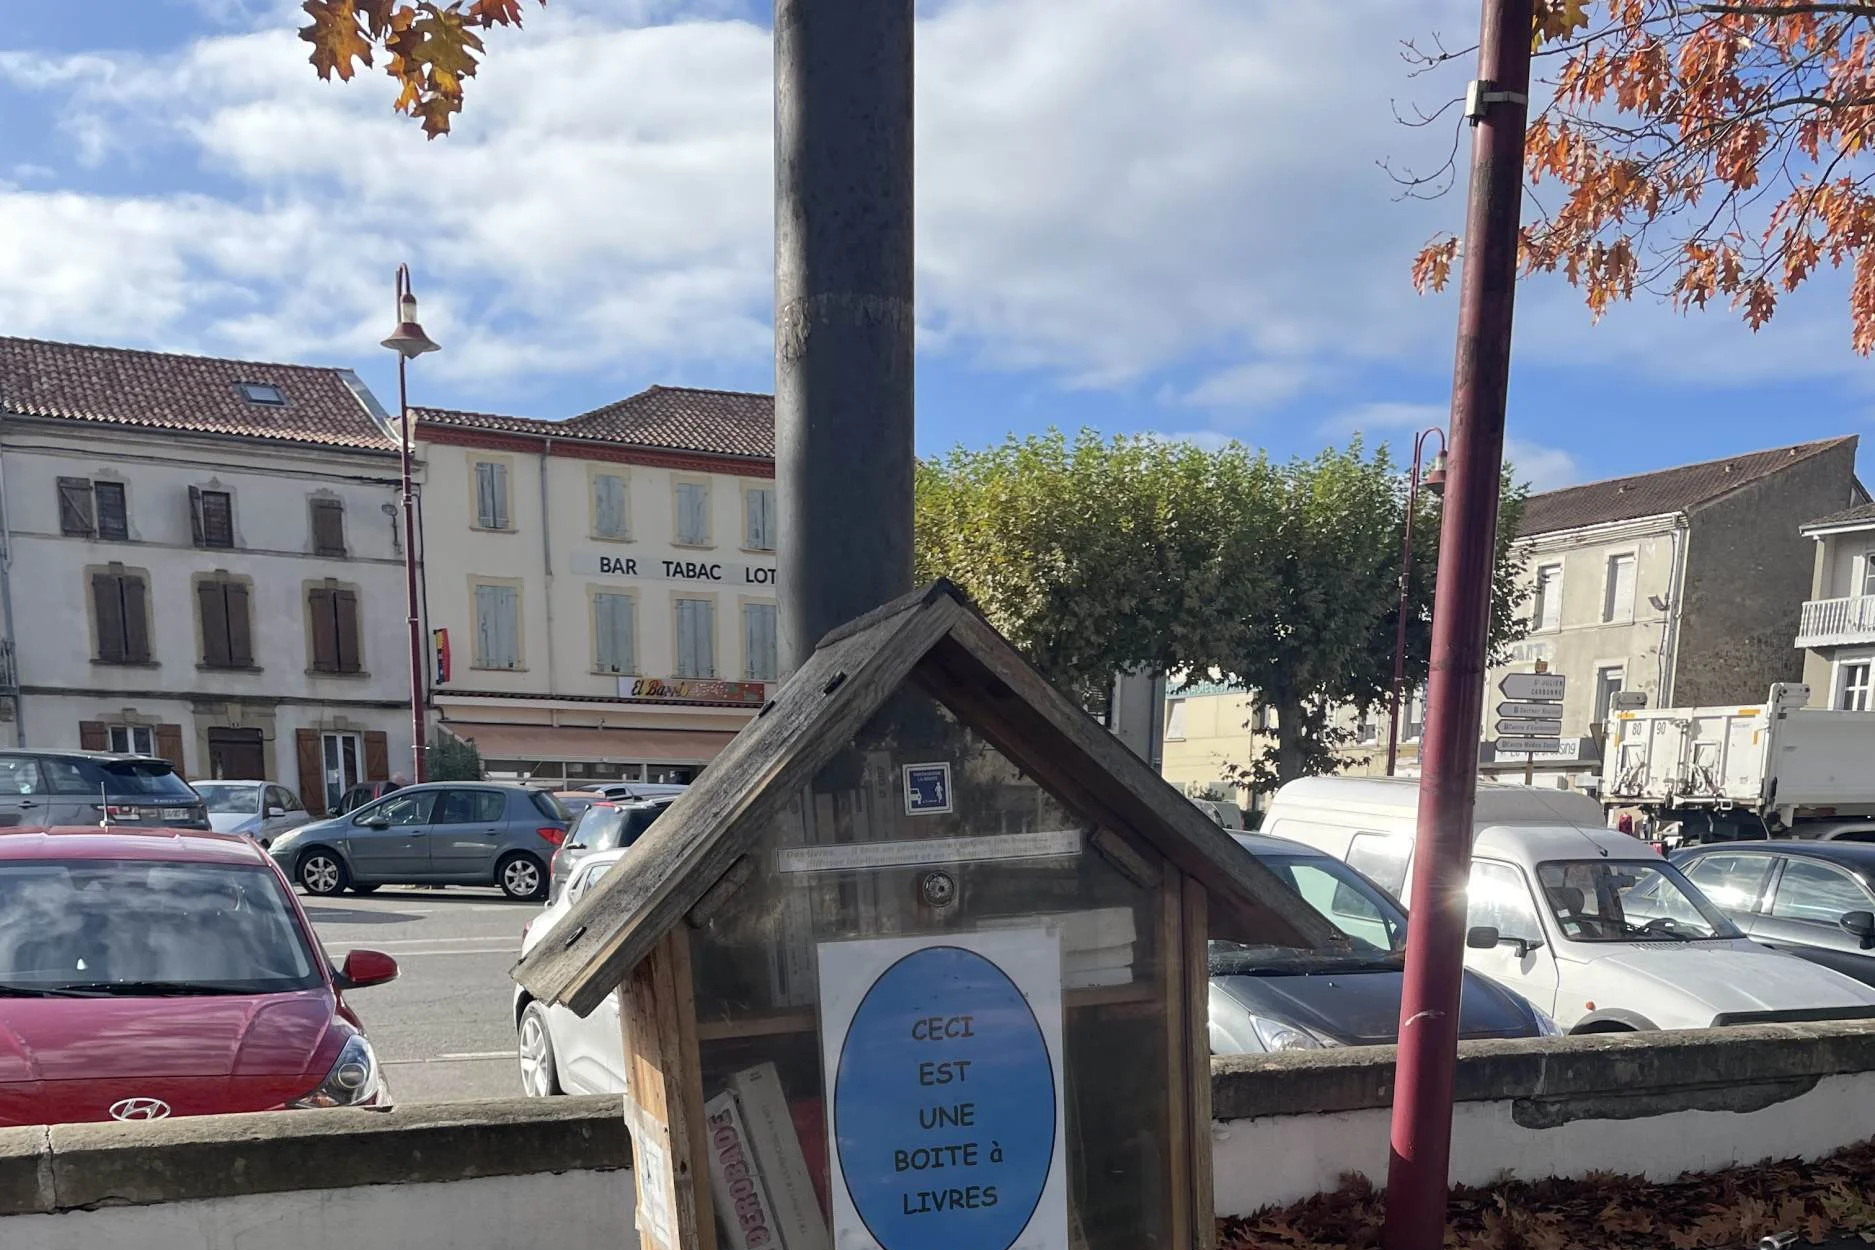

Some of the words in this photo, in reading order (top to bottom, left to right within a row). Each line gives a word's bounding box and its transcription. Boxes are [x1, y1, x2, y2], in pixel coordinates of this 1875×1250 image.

[600, 557, 638, 576] BAR
[662, 561, 722, 580] TABAC
[745, 567, 776, 585] LOT
[1632, 722, 1641, 736] 80
[1656, 721, 1666, 735] 90
[910, 1016, 975, 1041] CECI
[919, 1060, 971, 1085] EST
[919, 1103, 975, 1129] UNE
[894, 1142, 978, 1172] BOITE
[989, 1140, 1003, 1164] à
[903, 1185, 998, 1215] LIVRES
